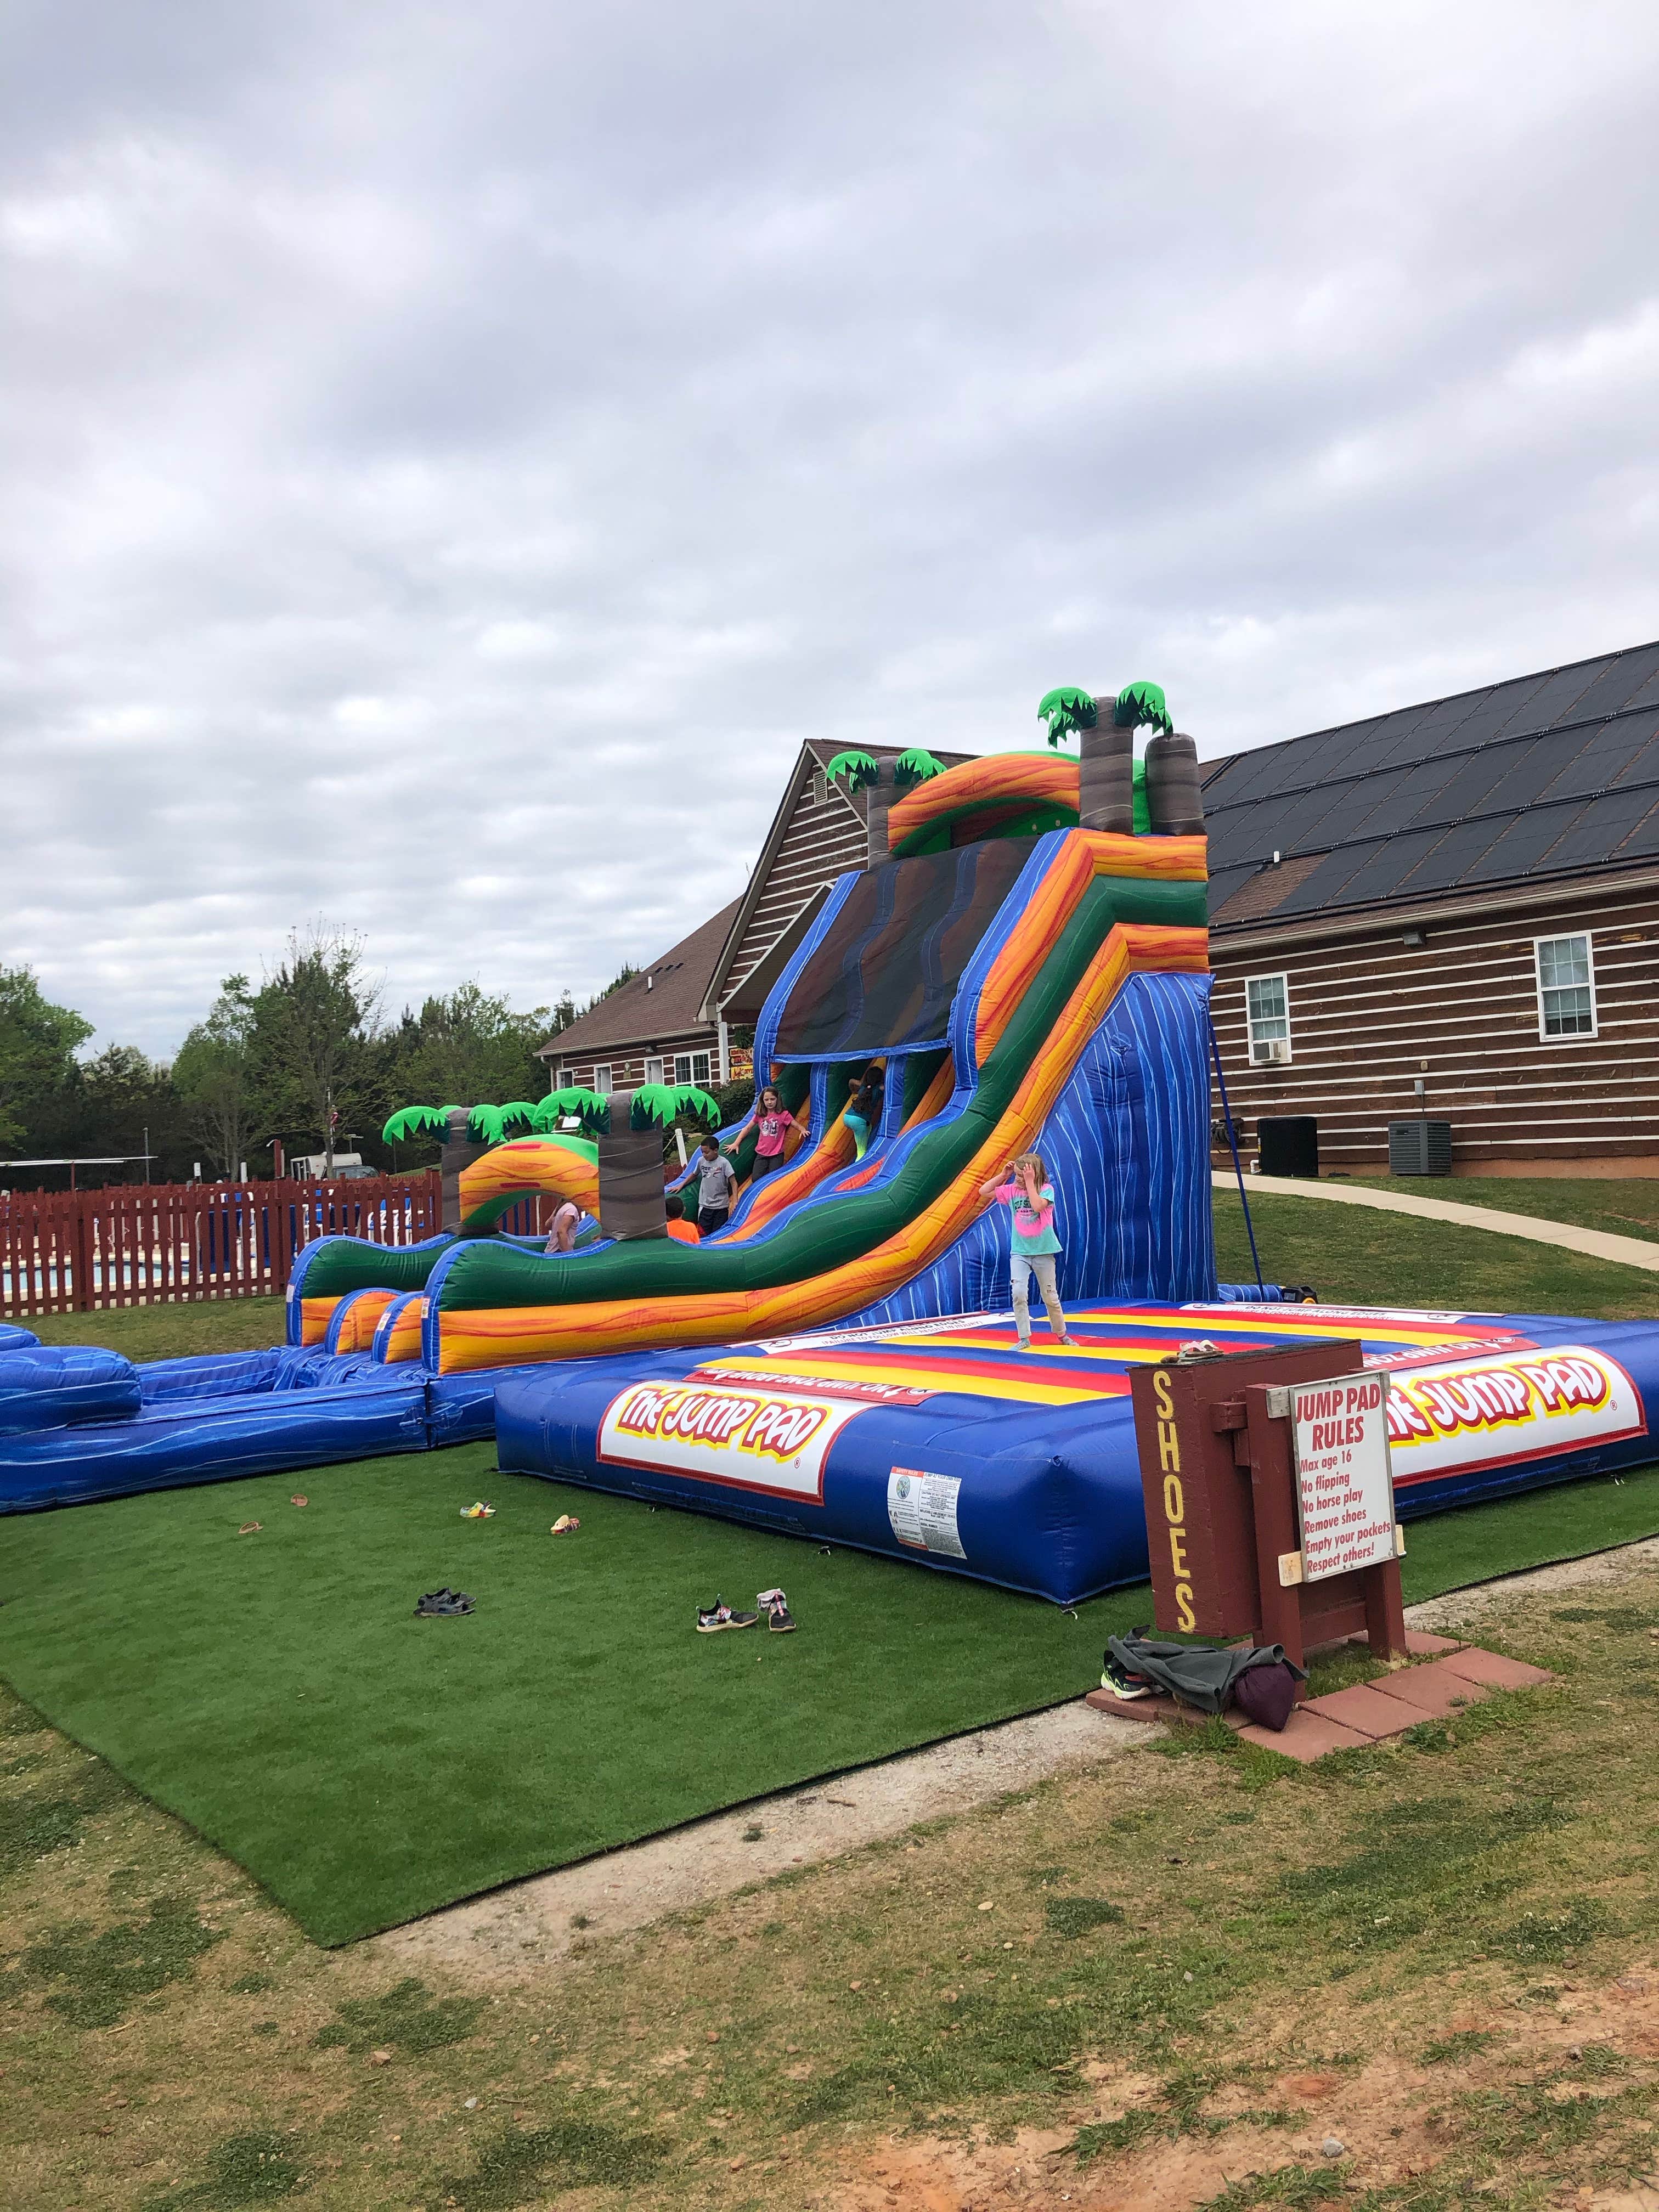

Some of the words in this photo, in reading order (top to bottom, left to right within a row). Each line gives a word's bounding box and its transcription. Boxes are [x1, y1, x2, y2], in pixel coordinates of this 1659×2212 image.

[900, 1323, 934, 1331] ALONG
[1363, 1354, 1407, 1368] ZON
[1296, 1390, 1344, 1424] JUMP
[1346, 1384, 1380, 1414] PAD
[1412, 1369, 1527, 1426] JUMP
[1519, 1358, 1604, 1407] PAD
[664, 1390, 758, 1440] JUMP
[746, 1404, 822, 1452] PAD
[1312, 1415, 1364, 1452] RULES
[1301, 1459, 1319, 1473] Max
[1322, 1455, 1338, 1470] age
[1342, 1449, 1352, 1464] 16
[1301, 1480, 1313, 1494] No
[1316, 1471, 1350, 1491] flipping
[1153, 1370, 1195, 1634] SHOES
[1302, 1499, 1314, 1514] No
[1317, 1496, 1341, 1510] horse
[1344, 1488, 1363, 1506] play
[1305, 1516, 1339, 1534] Remove
[1341, 1509, 1367, 1525] shoes
[1306, 1536, 1332, 1554] Empty
[1335, 1531, 1355, 1549] your
[1357, 1521, 1391, 1543] pockets
[1307, 1553, 1341, 1573] Respect
[1342, 1542, 1374, 1563] others!
